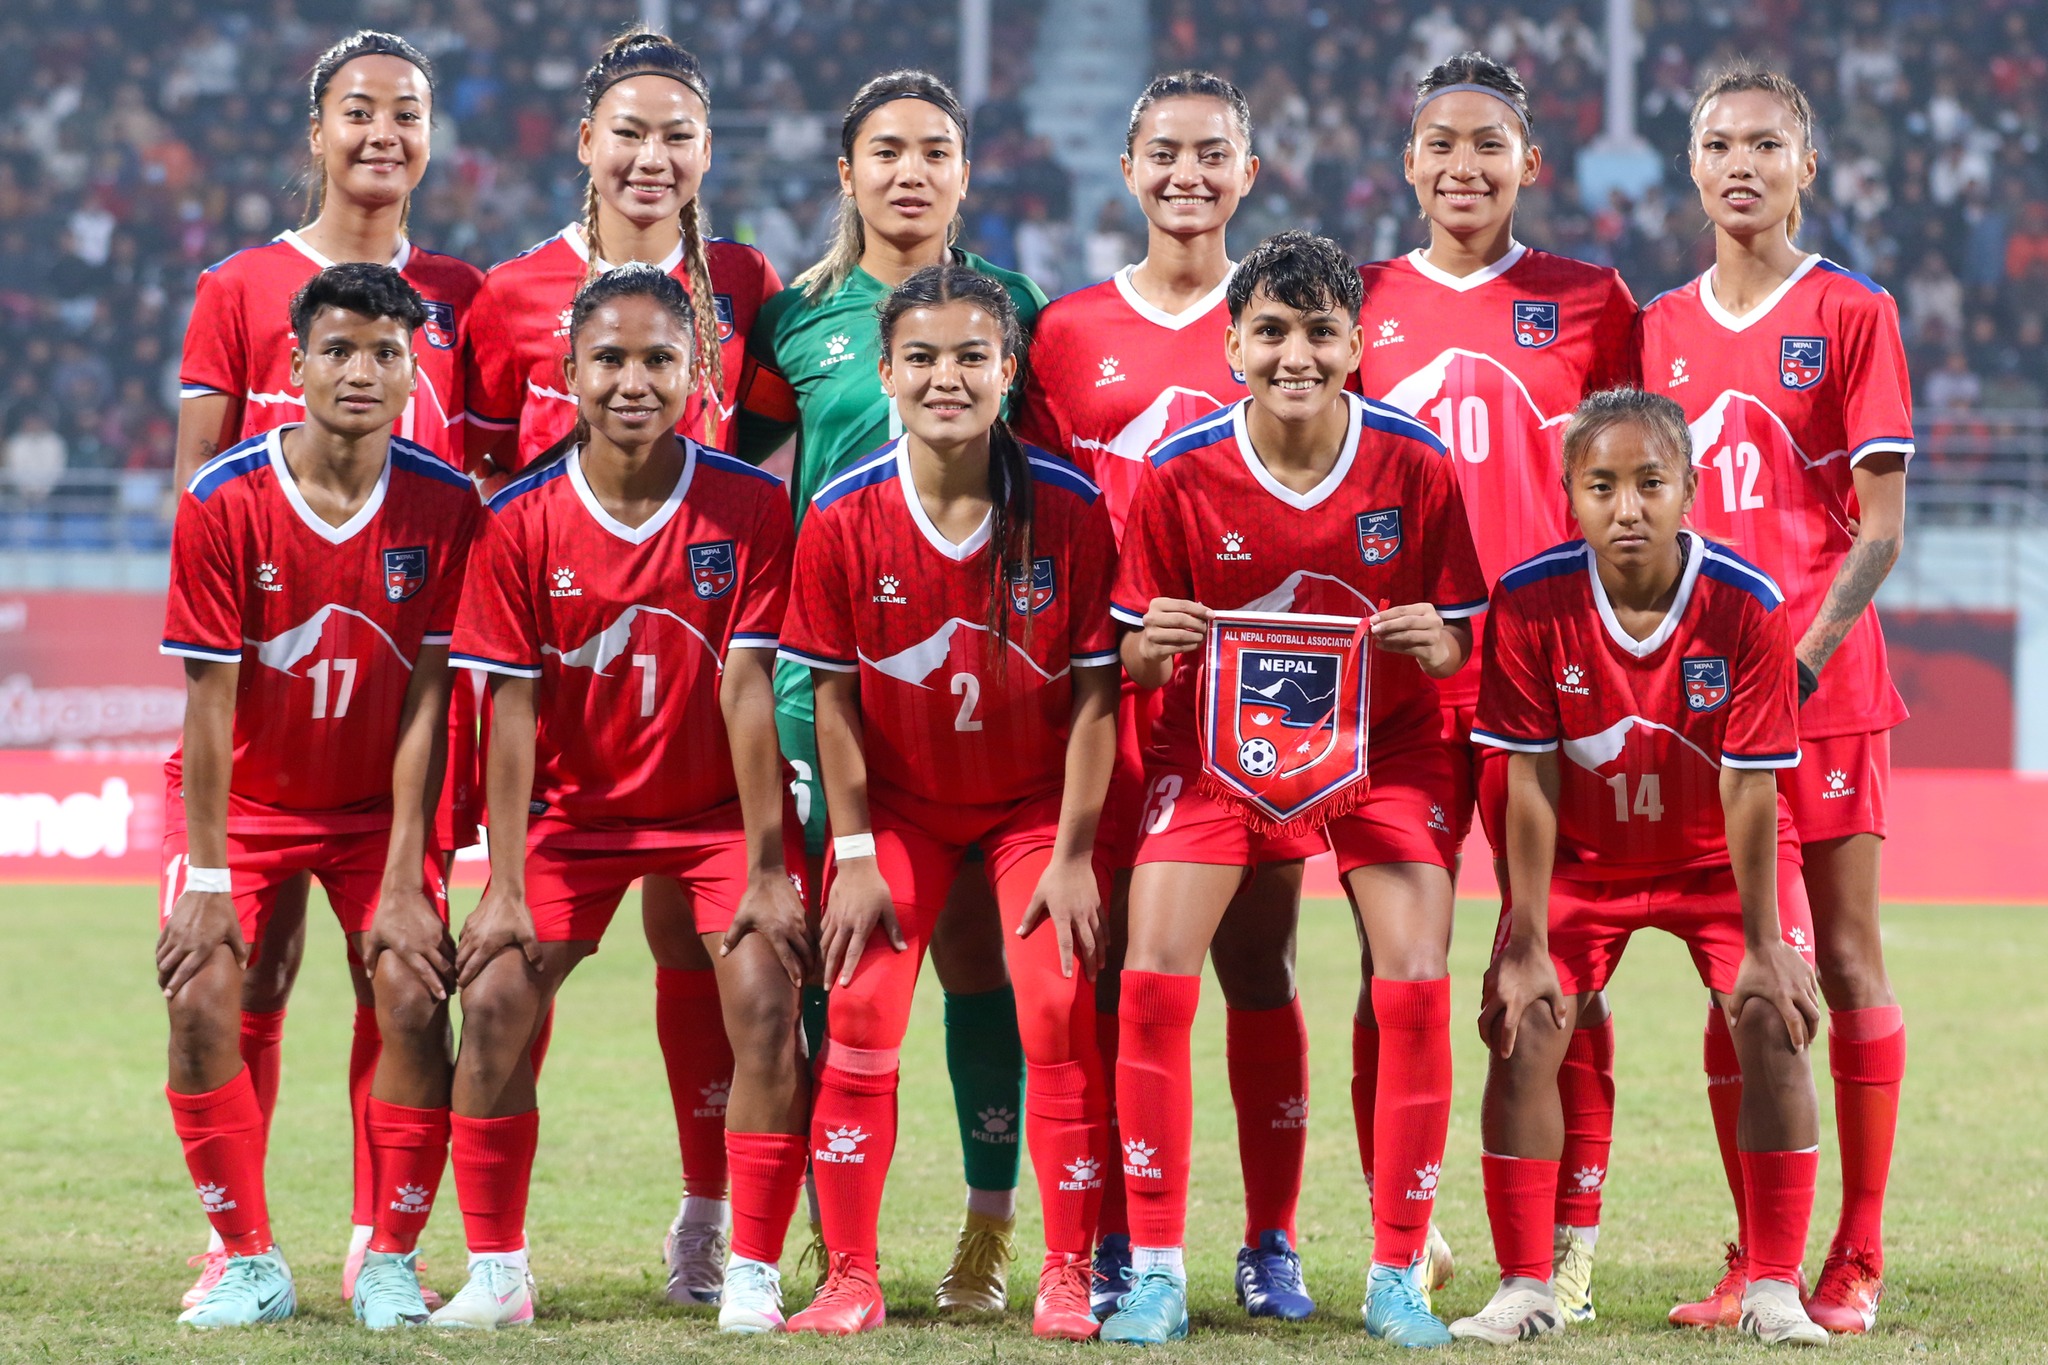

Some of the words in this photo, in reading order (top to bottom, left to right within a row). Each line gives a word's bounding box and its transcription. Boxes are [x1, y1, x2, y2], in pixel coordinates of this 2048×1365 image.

[1372, 334, 1405, 348] KELME
[1792, 341, 1813, 350] NEPAL
[819, 352, 856, 367] KELME
[1095, 373, 1126, 388] KELME
[1431, 394, 1490, 464] 10
[1712, 440, 1765, 513] 12
[1368, 514, 1389, 524] NEPAL
[700, 547, 721, 557] NEPAL
[1216, 552, 1252, 561] KELME
[549, 587, 583, 598] KELME
[872, 595, 907, 605] KELME
[1224, 631, 1239, 641] ALL
[1241, 632, 1265, 643] NEPAL
[1266, 633, 1305, 645] FOOTBALL
[1307, 635, 1352, 648] ASSOCIATIO
[1259, 658, 1318, 674] NEPAL
[1693, 662, 1714, 670] NEPAL
[306, 657, 358, 720] 17
[632, 653, 658, 718] 7
[1556, 681, 1590, 696] KELME
[950, 671, 983, 732] 2
[1606, 772, 1665, 823] 14
[1822, 787, 1856, 800] KELME
[971, 1129, 1018, 1144] KELME
[815, 1149, 865, 1164] KELME
[1123, 1163, 1162, 1179] KELME
[1059, 1178, 1103, 1191] KELME
[390, 1200, 431, 1213] KELME
